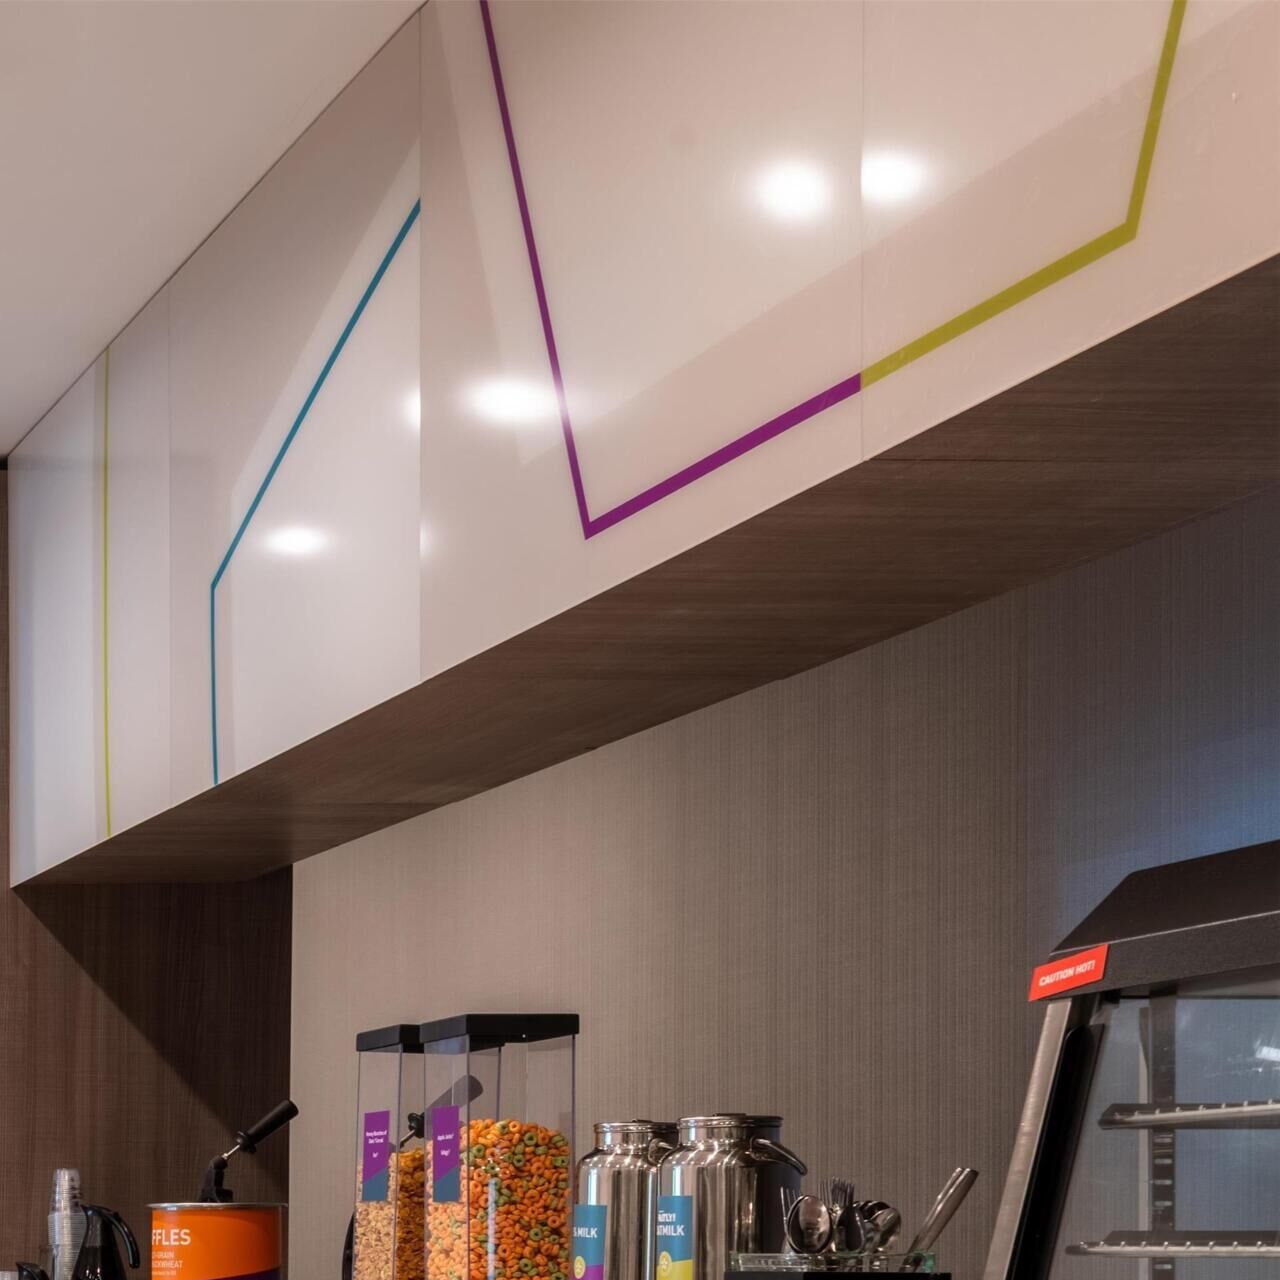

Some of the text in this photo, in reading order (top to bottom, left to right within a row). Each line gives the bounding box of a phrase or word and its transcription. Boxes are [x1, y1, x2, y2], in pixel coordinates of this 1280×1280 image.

[1039, 959, 1096, 987] CAUTION HOT!
[577, 1227, 598, 1239] MILK
